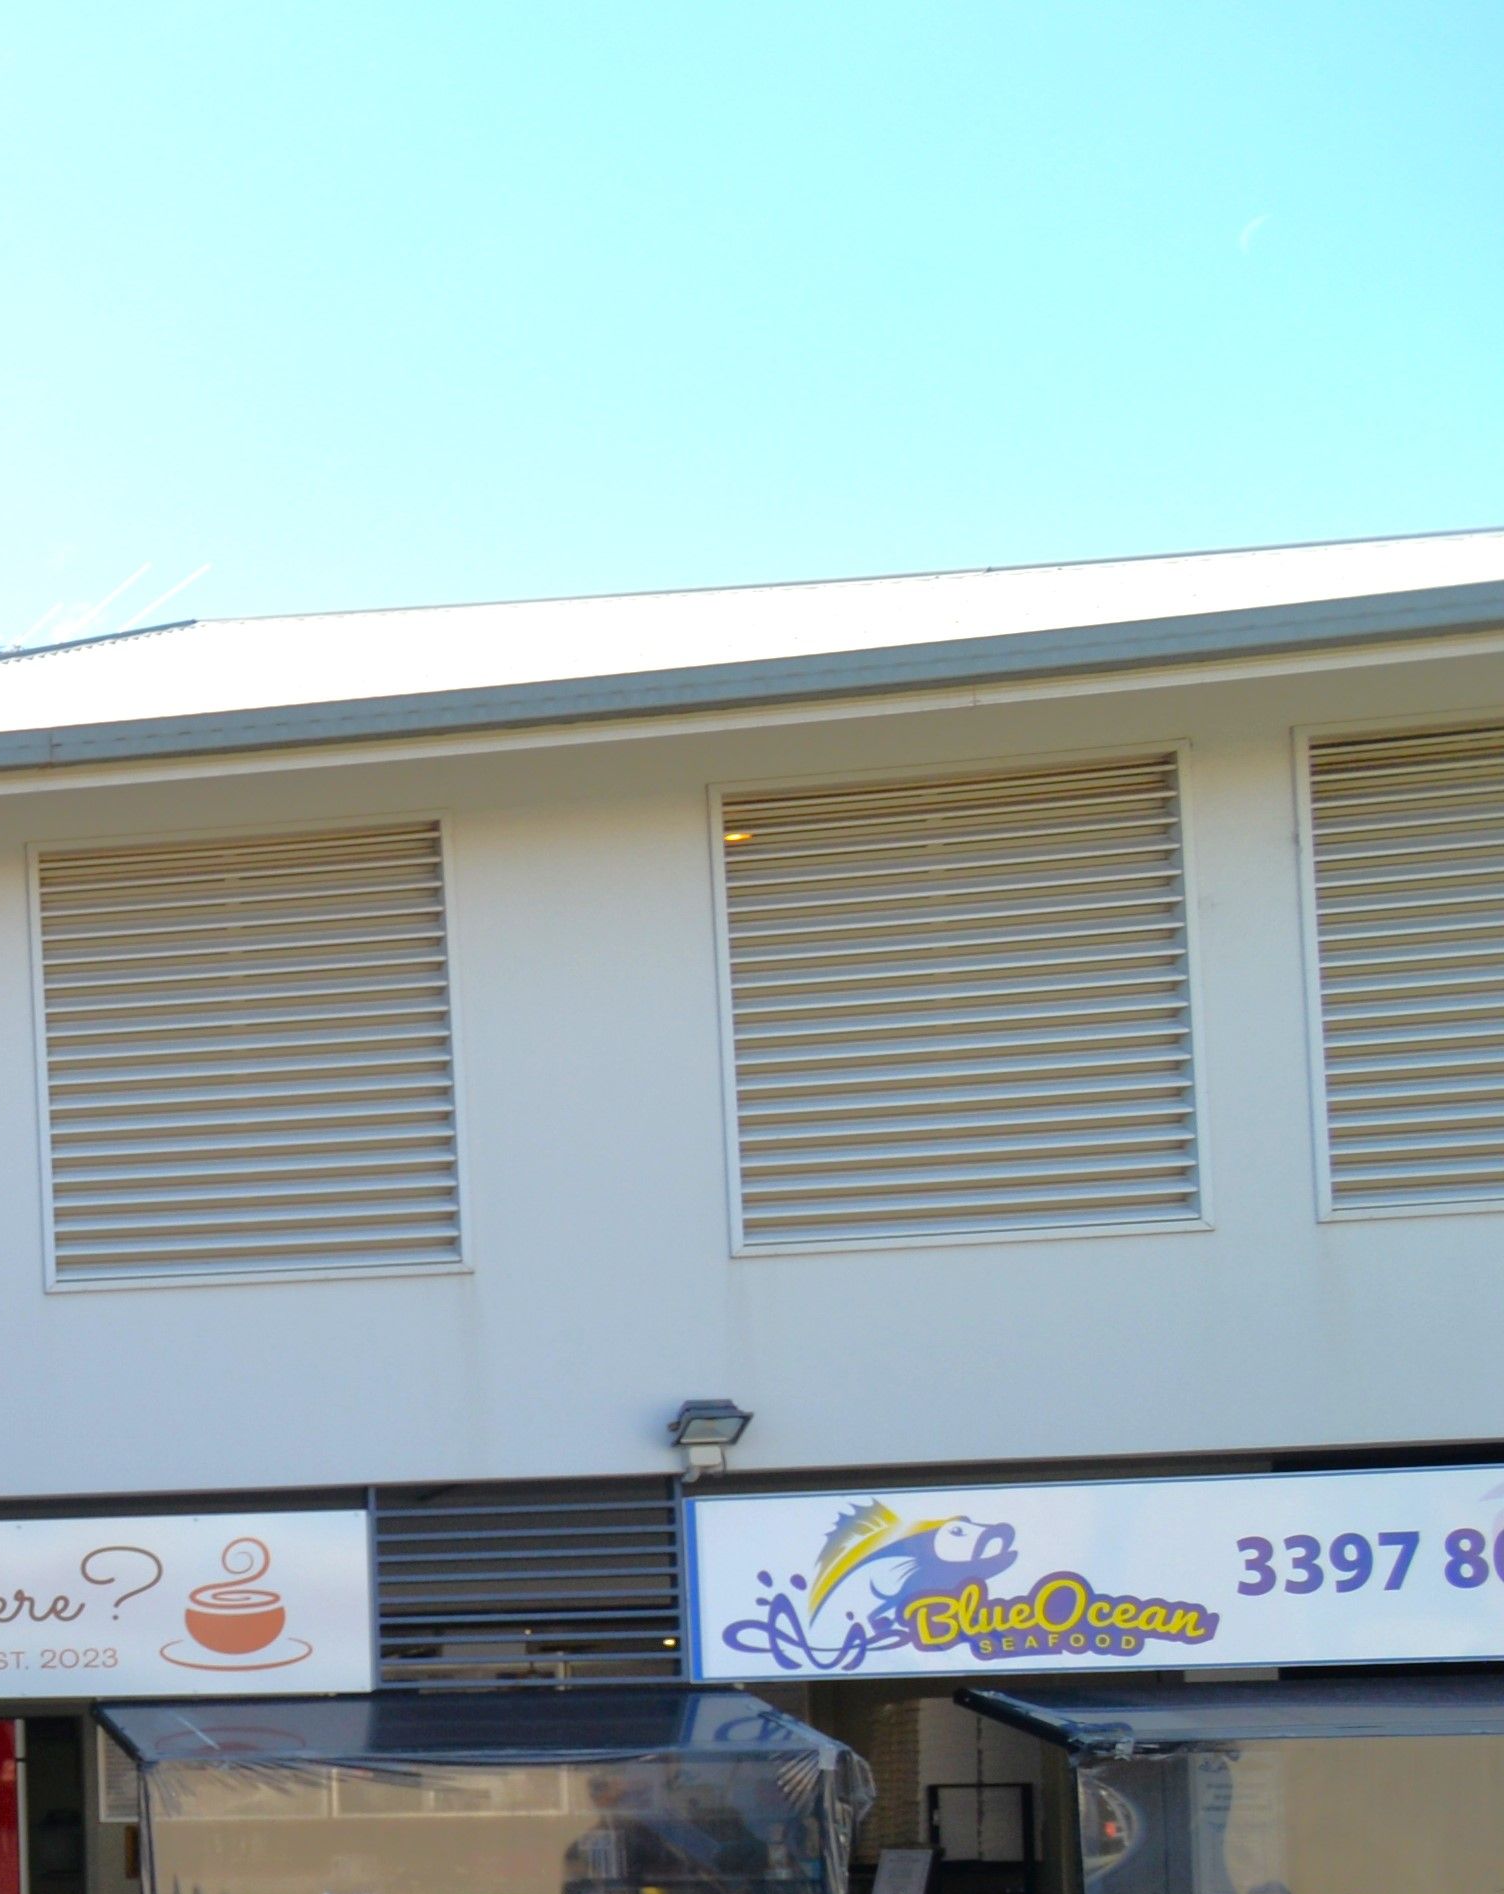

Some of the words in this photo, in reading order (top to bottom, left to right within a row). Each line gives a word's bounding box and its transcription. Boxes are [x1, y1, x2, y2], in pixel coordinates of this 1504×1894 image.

[1236, 1530, 1420, 1596] 3397
[1444, 1527, 1504, 1589] 8
[978, 1634, 1137, 1654] SEAFOOD
[40, 1647, 119, 1669] 2023
